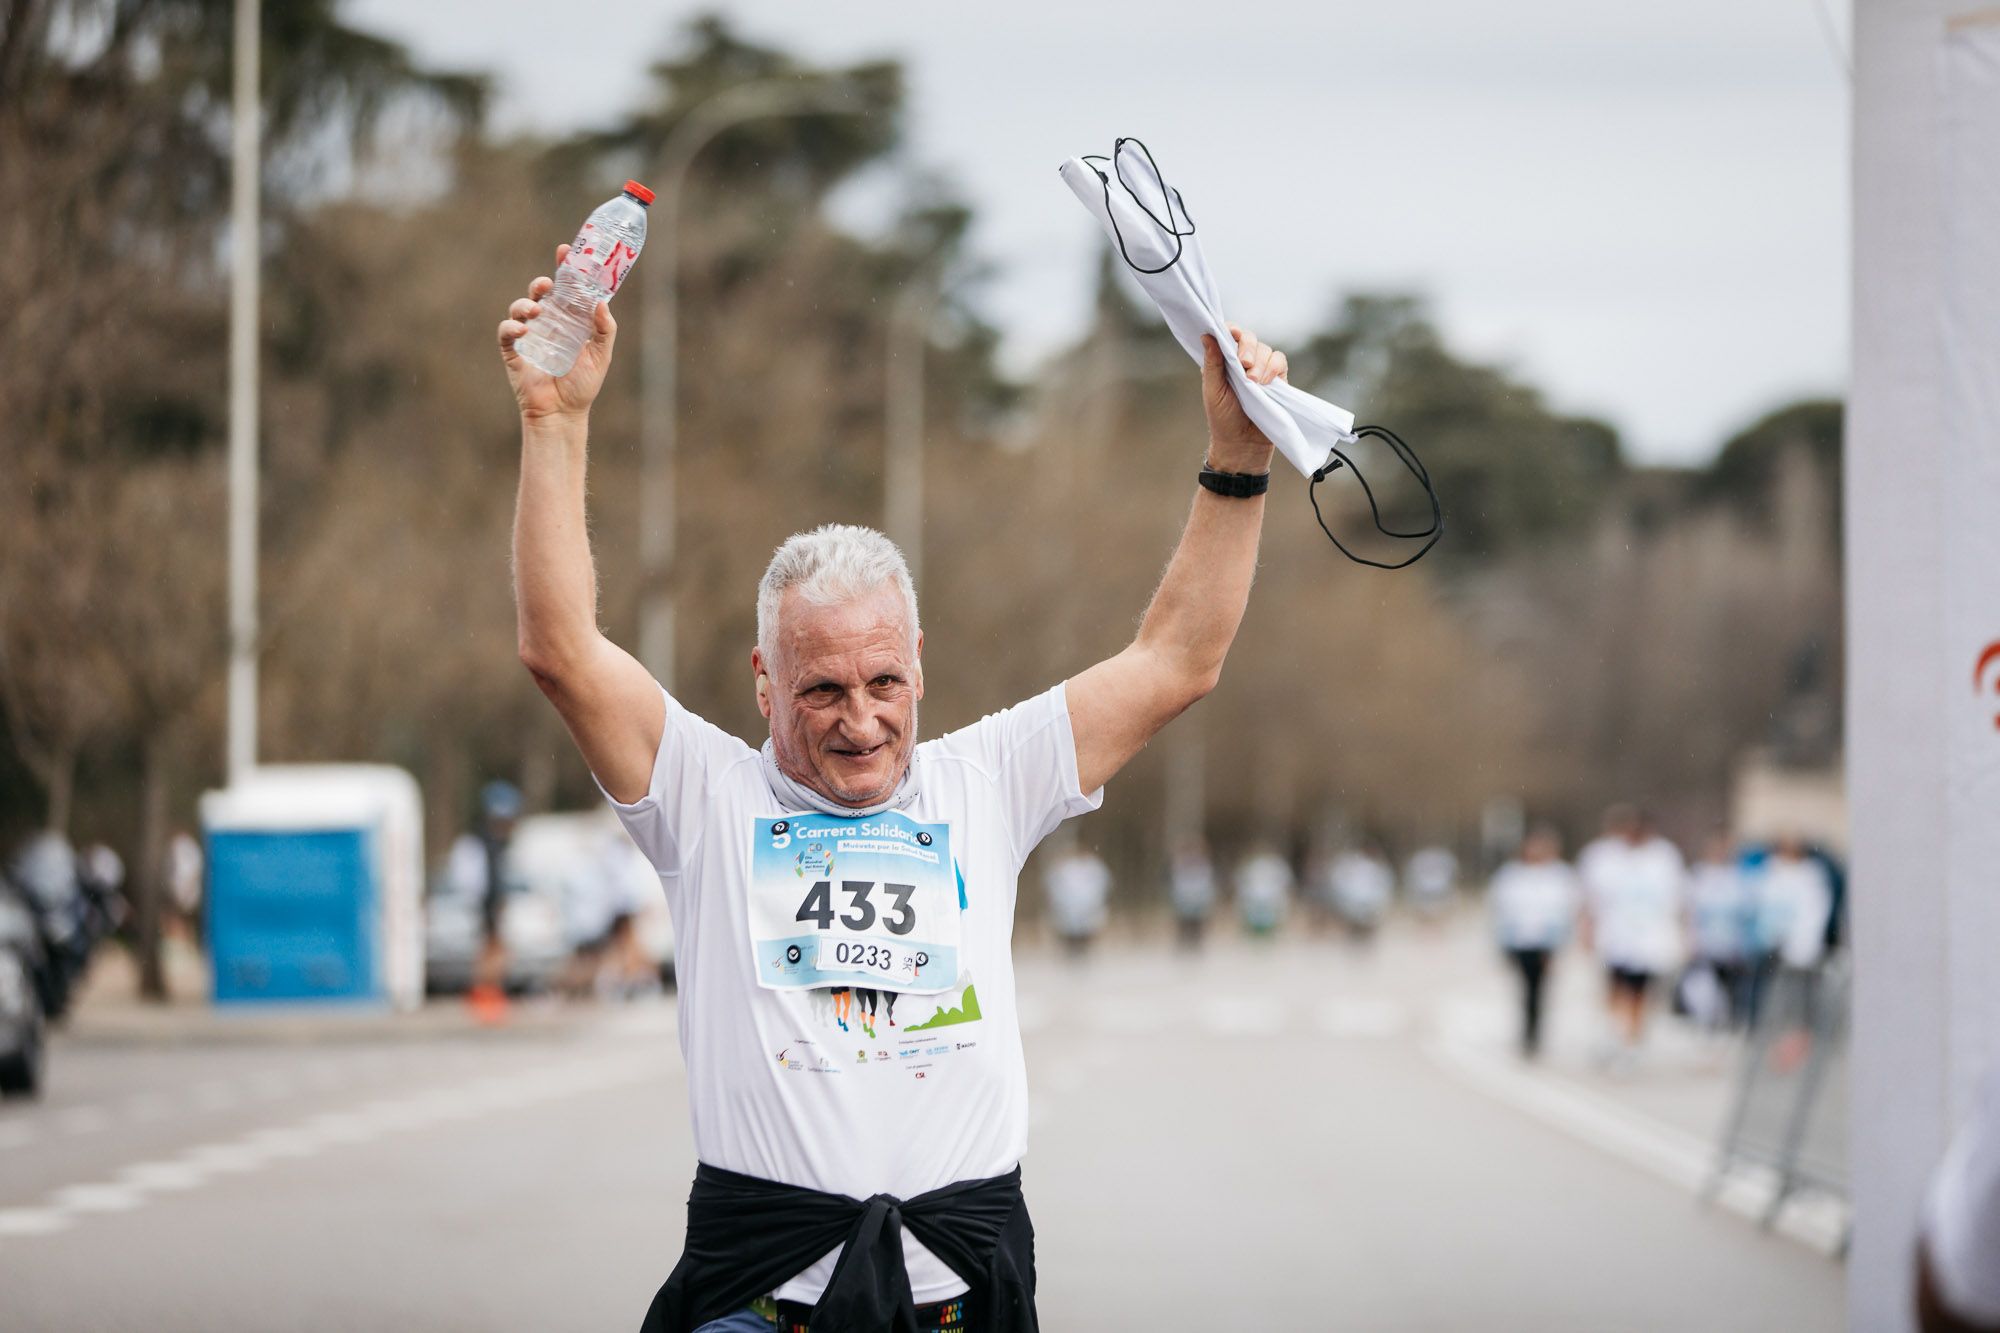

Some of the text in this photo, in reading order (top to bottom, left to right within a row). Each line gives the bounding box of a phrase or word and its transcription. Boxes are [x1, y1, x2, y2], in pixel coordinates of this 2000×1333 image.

[796, 825, 857, 839] Carrera
[796, 881, 916, 935] 433
[837, 943, 892, 970] 0233
